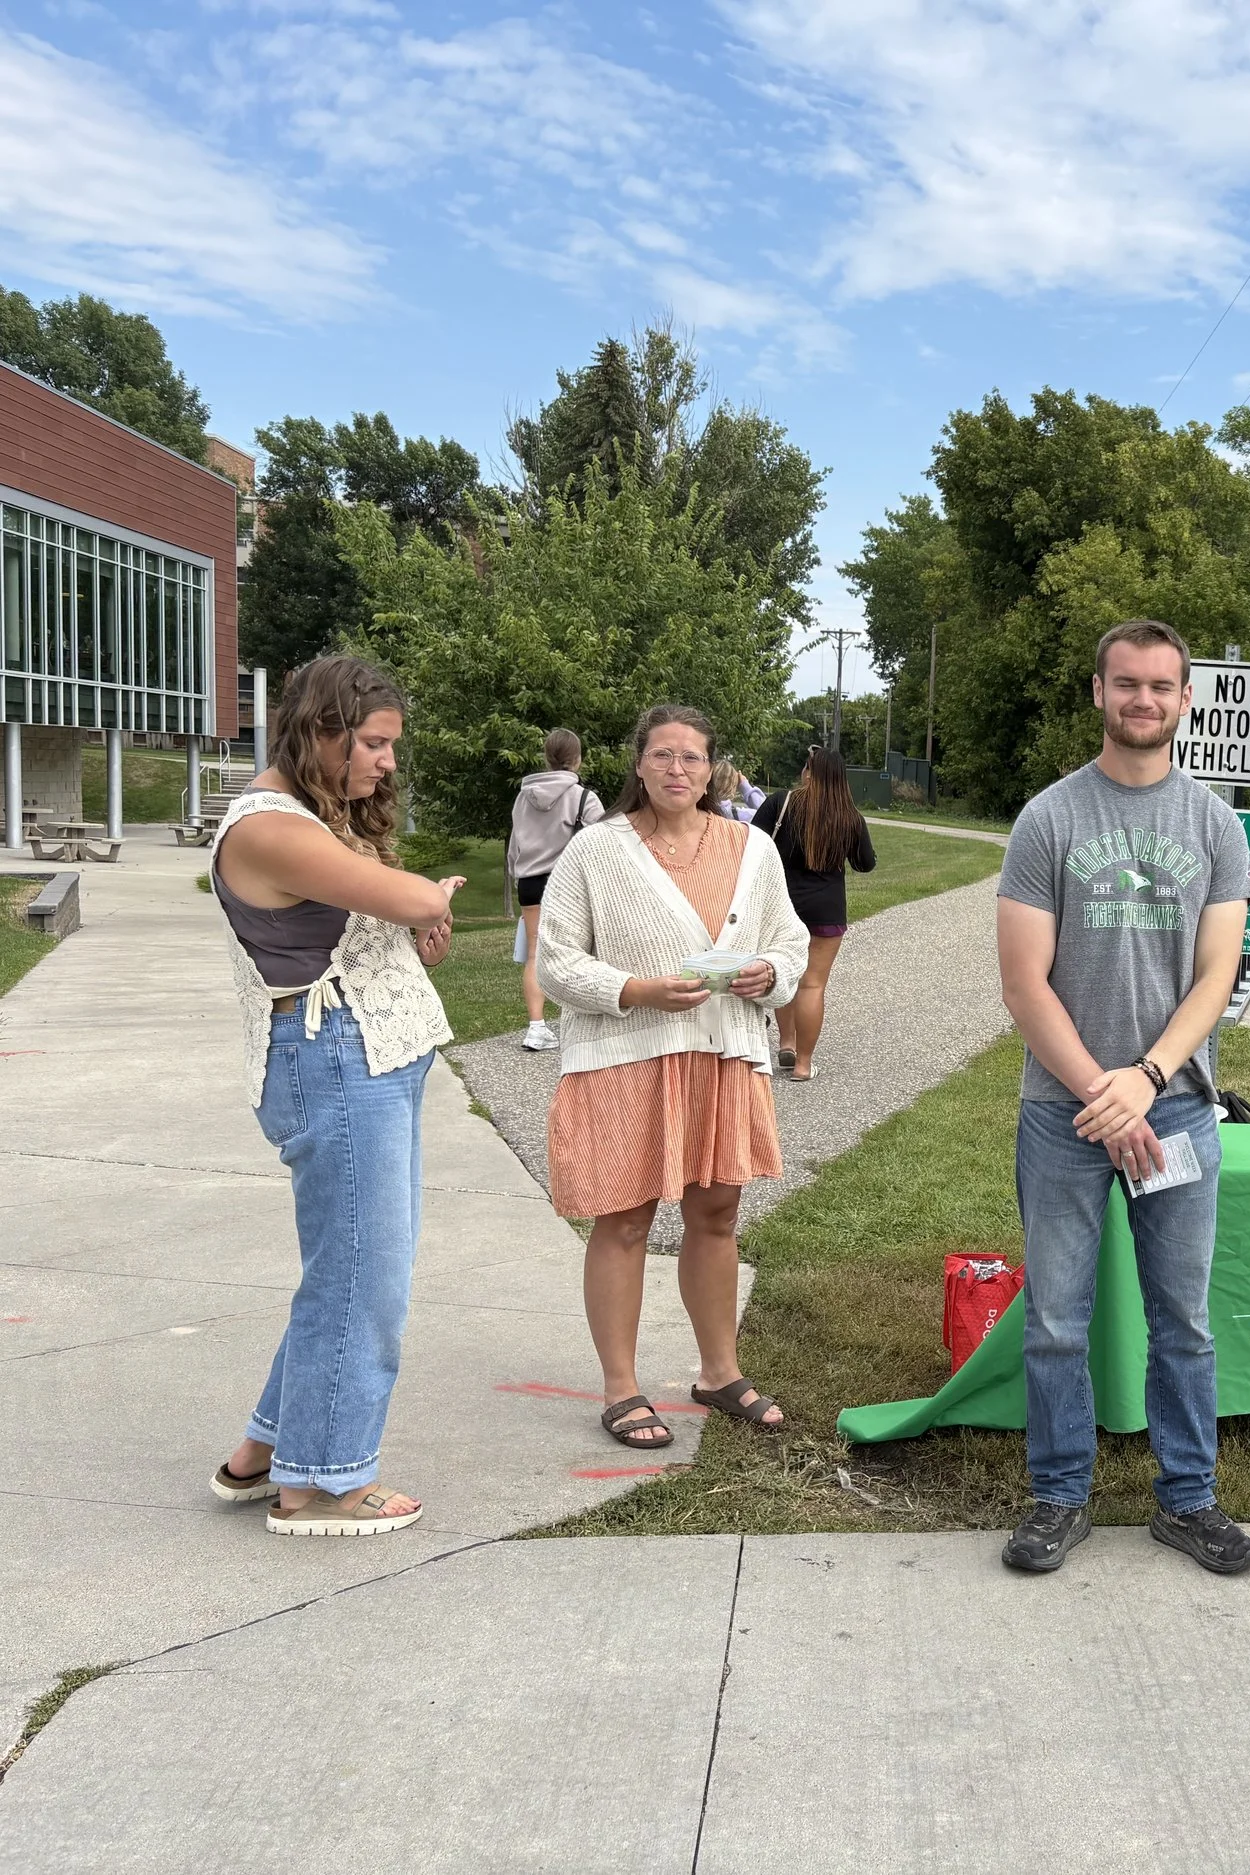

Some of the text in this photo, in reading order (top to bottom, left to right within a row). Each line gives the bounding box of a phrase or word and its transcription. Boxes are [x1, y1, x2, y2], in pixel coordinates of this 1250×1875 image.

[1215, 674, 1246, 704] NO
[1065, 827, 1203, 888] NORTH DAKOTA
[1093, 884, 1114, 894] EST.
[1155, 886, 1177, 897] 1883
